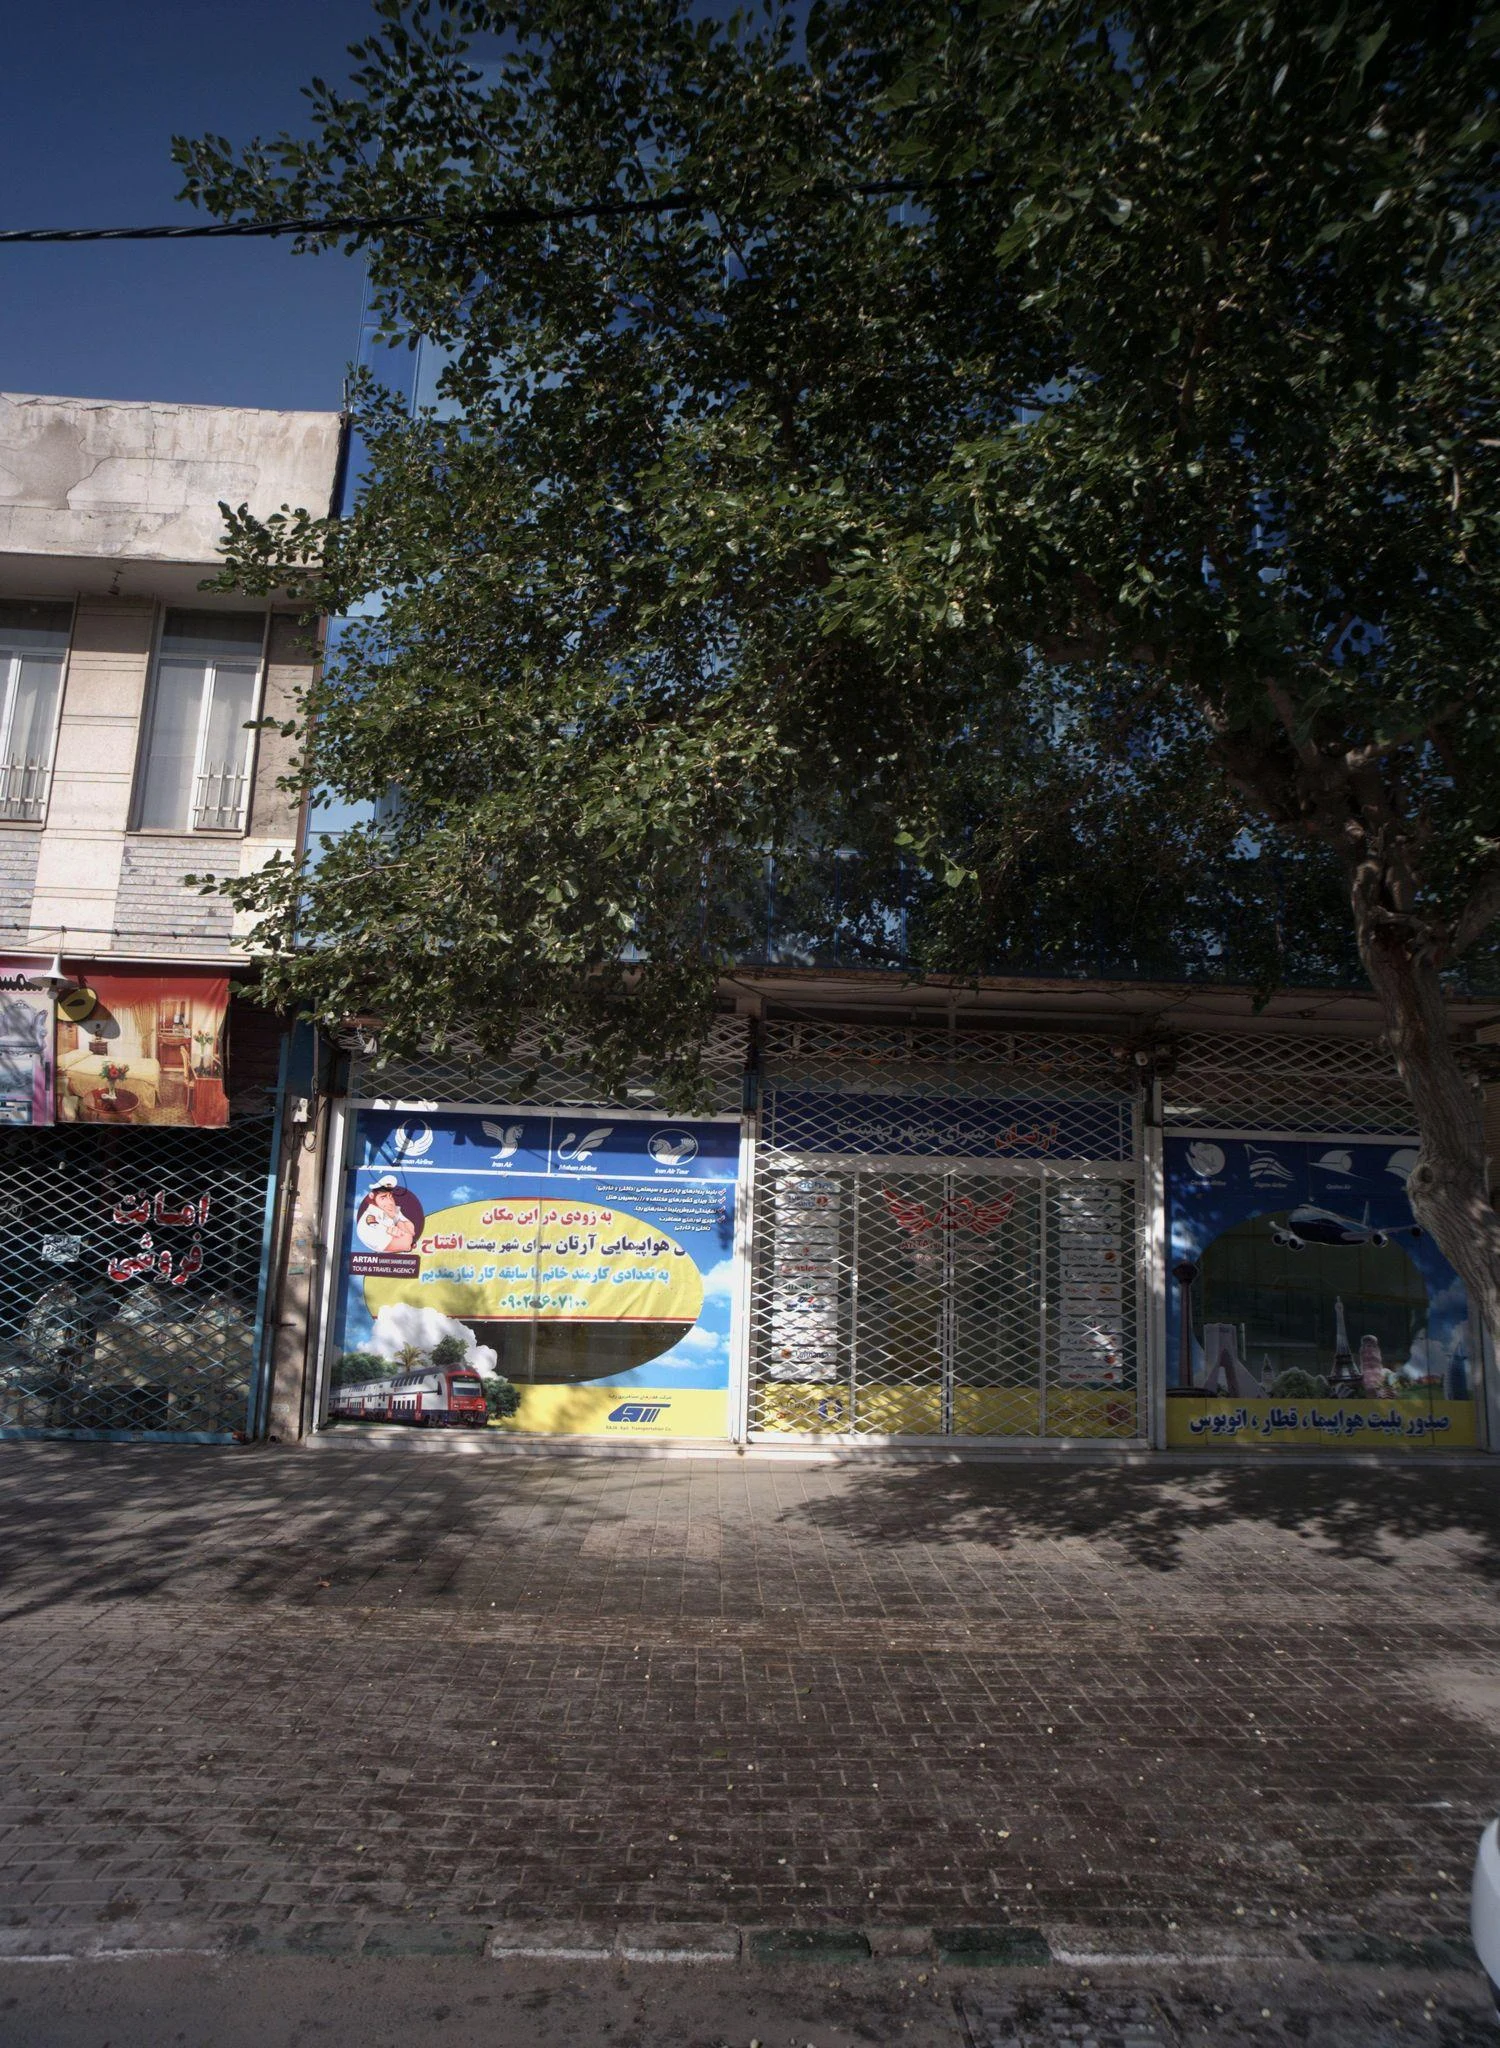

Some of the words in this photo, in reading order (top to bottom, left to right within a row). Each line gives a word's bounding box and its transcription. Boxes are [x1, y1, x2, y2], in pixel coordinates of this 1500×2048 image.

[482, 1207, 514, 1225] مکان
[517, 1208, 539, 1225] این
[542, 1210, 557, 1225] در
[560, 1210, 597, 1226] زودی
[600, 1211, 612, 1225] به
[421, 1233, 463, 1254] افتتاح
[466, 1238, 496, 1253] بهشت
[498, 1238, 519, 1254] شهر
[522, 1238, 551, 1253] سرای
[555, 1233, 597, 1255] آرتان
[600, 1236, 670, 1257] هواپیمایی
[352, 1255, 379, 1264] ARTAN
[421, 1265, 475, 1283] نیازمندیم
[477, 1266, 496, 1283] کار
[498, 1266, 528, 1282] سابقه
[542, 1266, 569, 1282] خانم
[571, 1266, 610, 1283] کارمند
[612, 1267, 656, 1283] تعدادی
[658, 1269, 669, 1284] به
[500, 1294, 588, 1309] ۰۹۰۲۶۰۷۱۰۰
[1189, 1407, 1247, 1435] اتوبوس
[1367, 1408, 1402, 1434] بلیت
[1406, 1411, 1450, 1435] صدور
